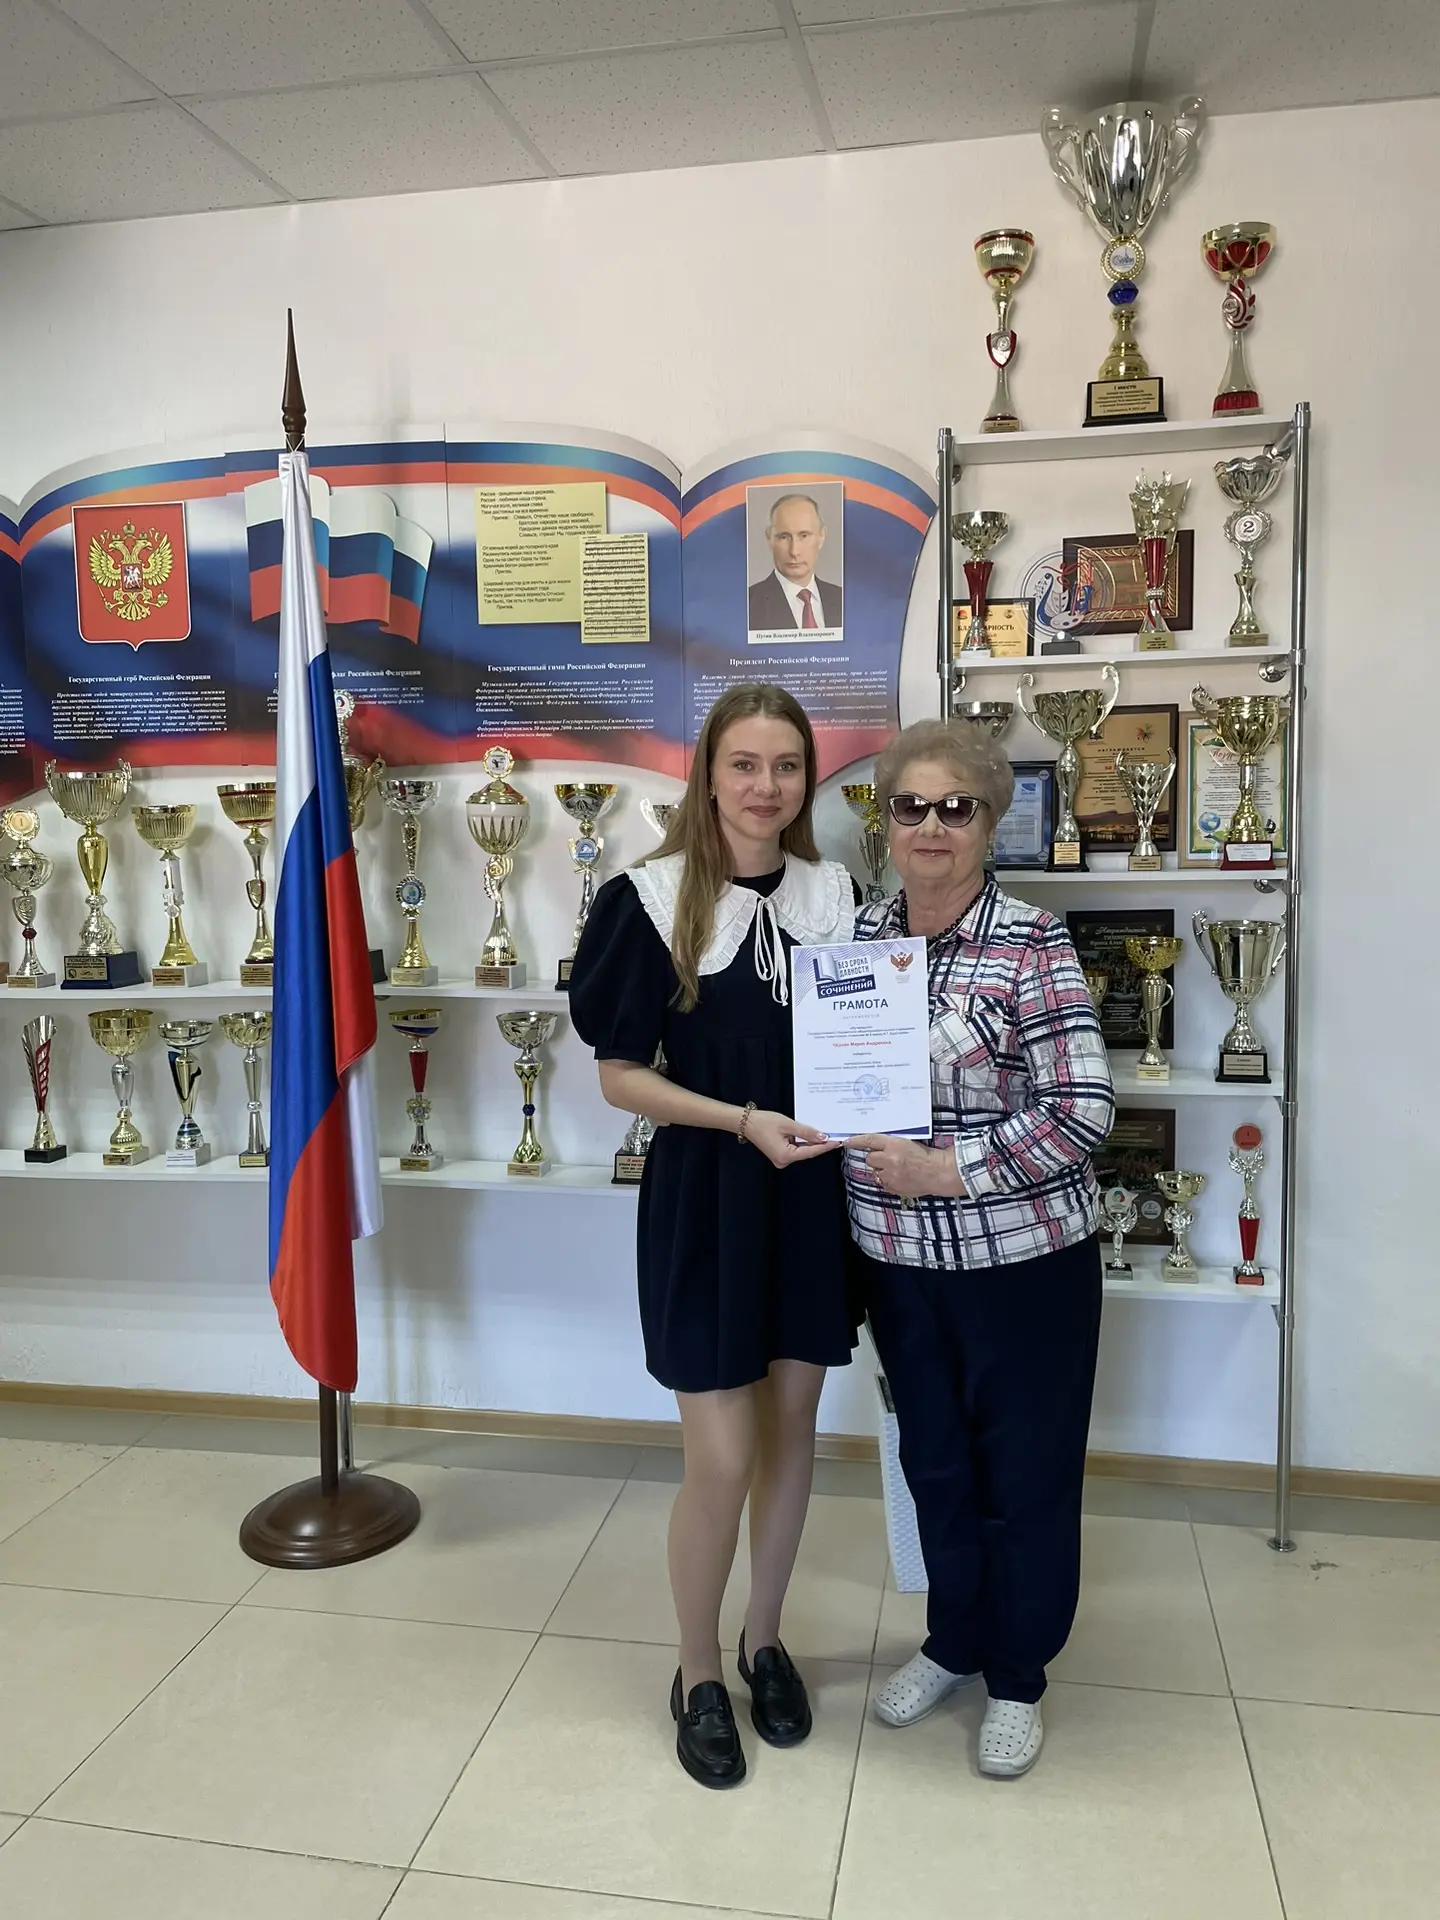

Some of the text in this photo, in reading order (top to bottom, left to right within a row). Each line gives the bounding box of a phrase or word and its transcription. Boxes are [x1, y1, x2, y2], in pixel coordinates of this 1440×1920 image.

[1244, 520, 1254, 533] 2
[730, 656, 850, 666] Президент Российской Федерации
[488, 664, 546, 673] Государственный
[607, 662, 646, 670] Федерации
[69, 676, 122, 684] Государственный
[123, 675, 138, 683] герб
[175, 674, 211, 682] Федерации
[386, 670, 421, 678] Федерации
[838, 957, 868, 969] БЕЗ СРОКА
[839, 965, 869, 978] ДАВНОСТИ
[820, 980, 873, 996] СОЧИНЕНИЙ
[833, 998, 888, 1010] ГРАМОТА
